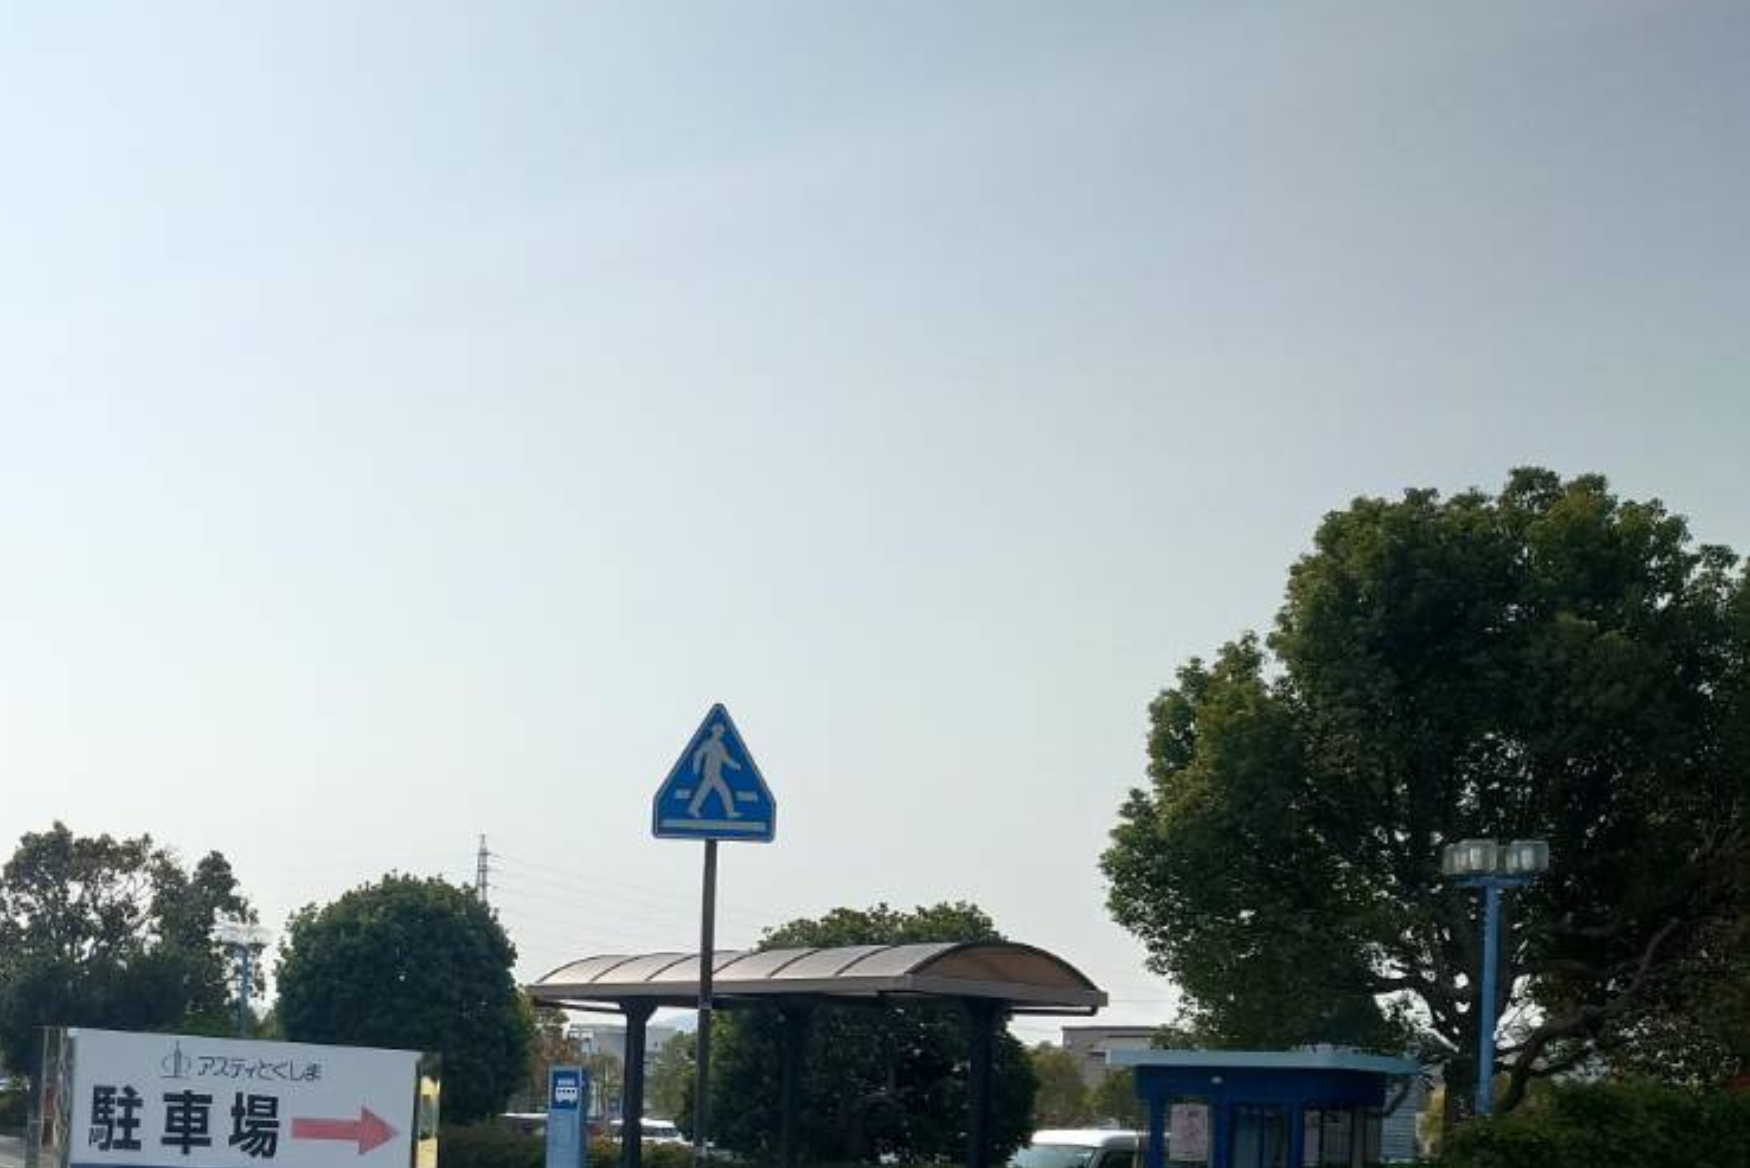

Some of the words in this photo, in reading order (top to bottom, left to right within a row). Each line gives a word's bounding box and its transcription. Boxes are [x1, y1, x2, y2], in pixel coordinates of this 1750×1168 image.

[198, 1056, 322, 1082] アスティとくしま
[88, 1085, 280, 1159] 駐車場
